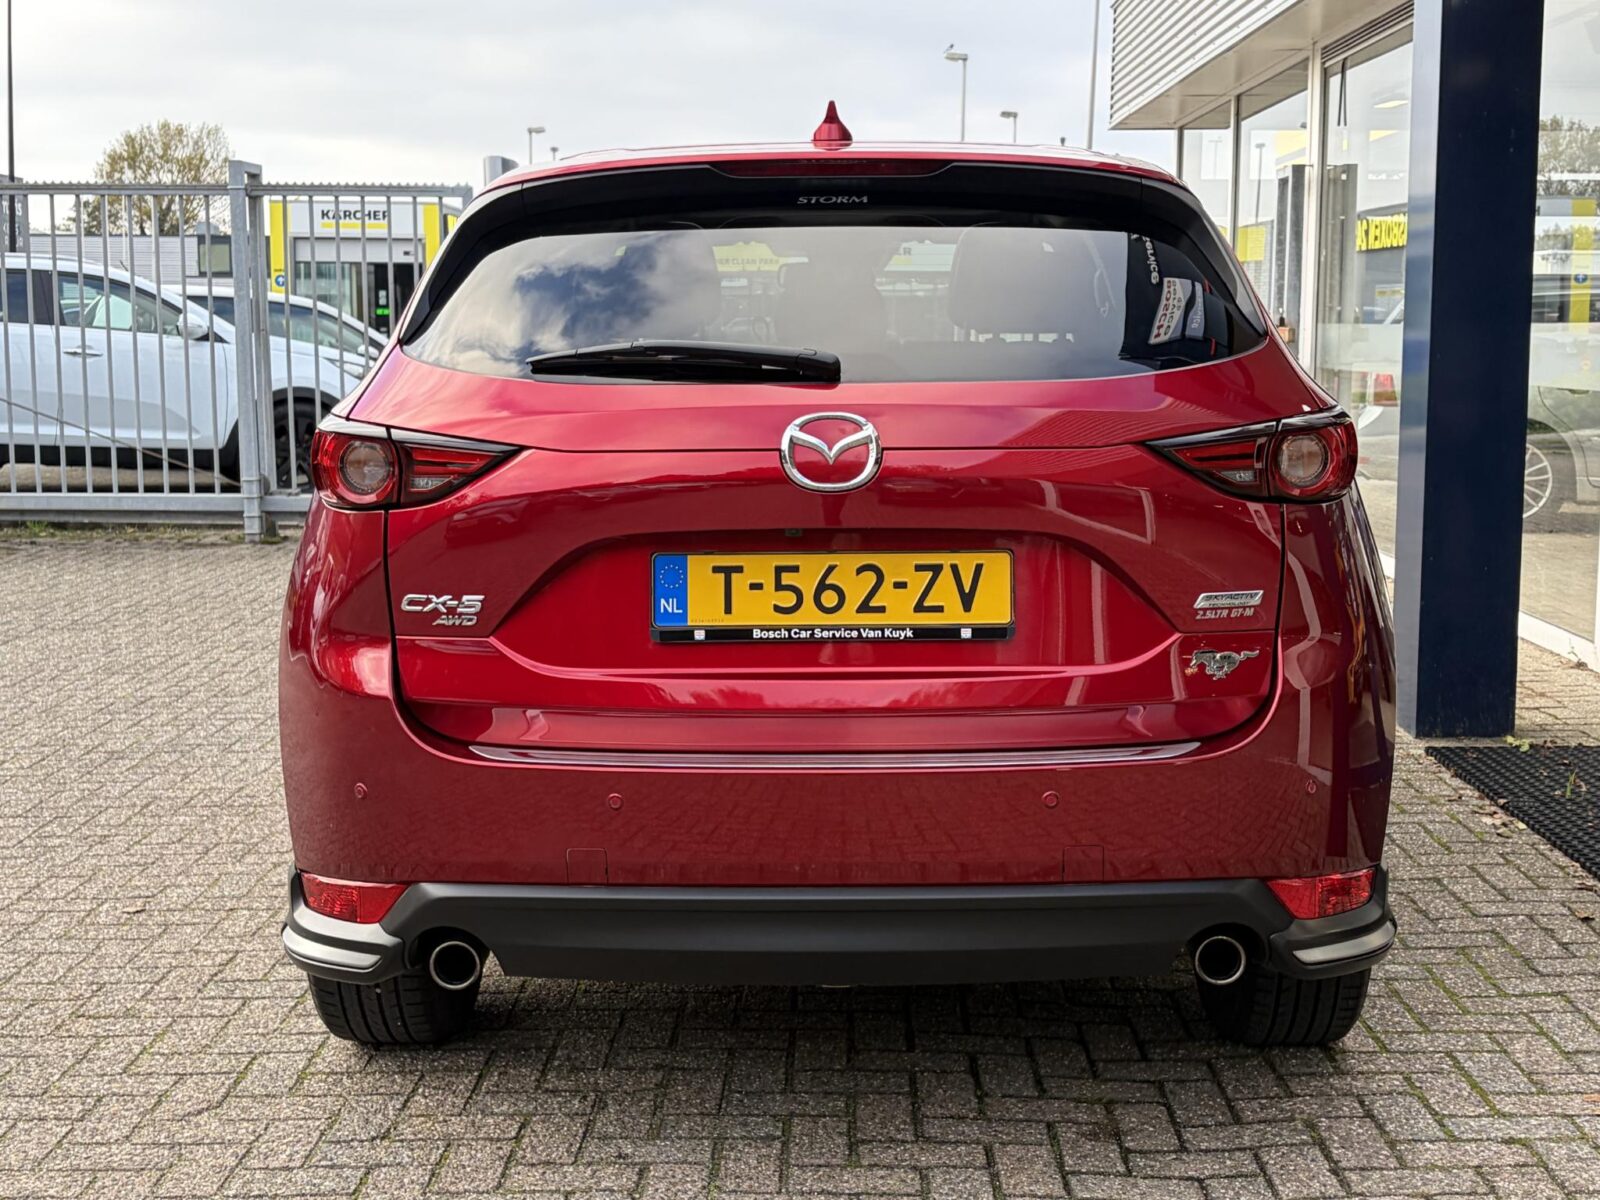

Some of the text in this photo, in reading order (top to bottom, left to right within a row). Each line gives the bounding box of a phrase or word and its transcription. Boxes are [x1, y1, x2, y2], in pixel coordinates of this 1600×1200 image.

[797, 196, 868, 204] STORM
[711, 562, 984, 615] T-562-ZV
[401, 593, 485, 613] CX-5
[660, 598, 683, 613] NL
[432, 615, 478, 626] AWD
[1195, 609, 1229, 620] 2.5LTR
[752, 627, 914, 640] Bosch Car Service Van Kuyk
